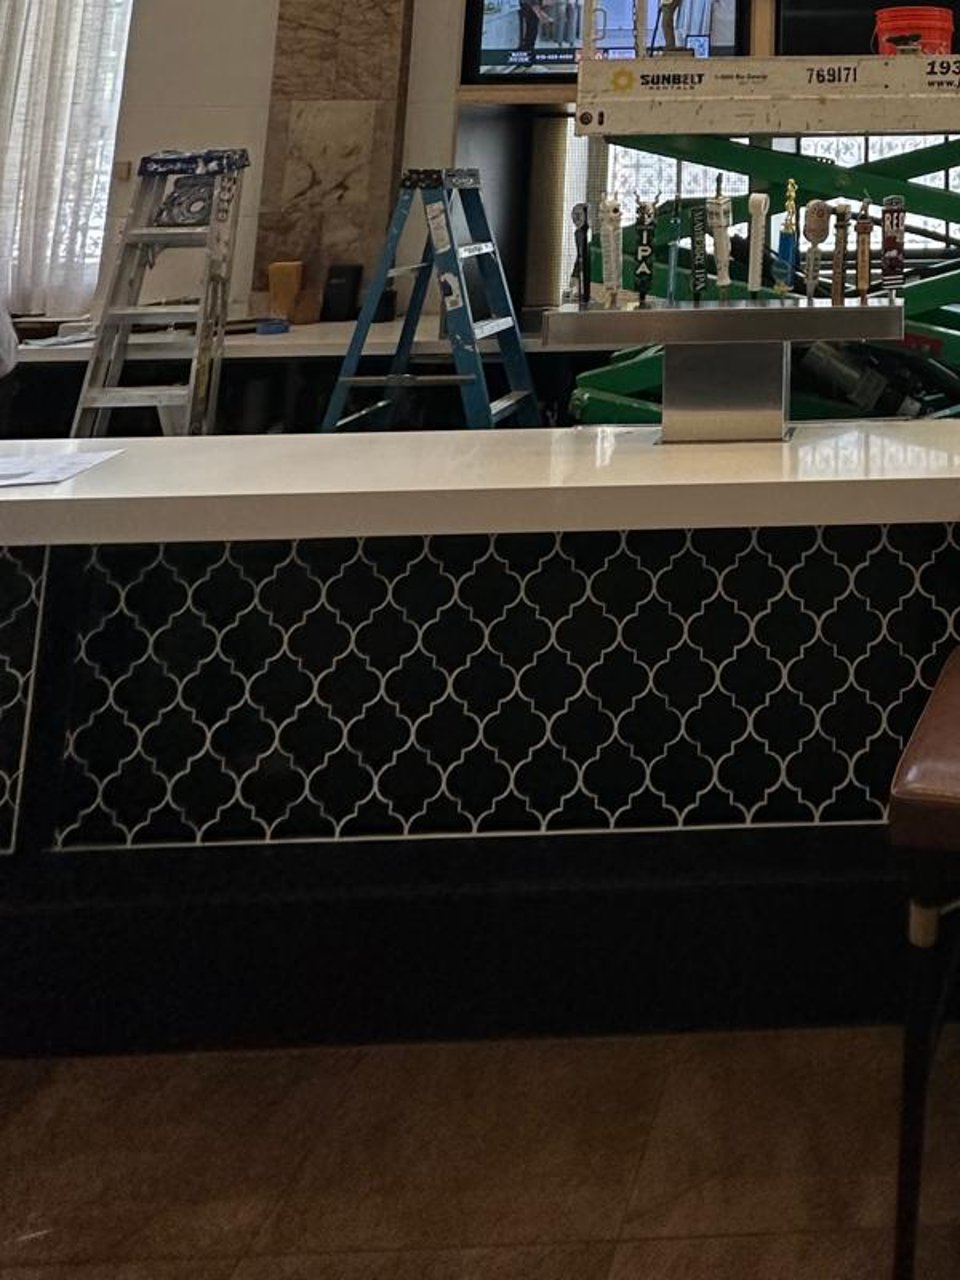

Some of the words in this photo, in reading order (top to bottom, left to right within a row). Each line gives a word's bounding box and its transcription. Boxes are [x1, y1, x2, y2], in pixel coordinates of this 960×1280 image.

[640, 73, 704, 85] SUNBELT
[806, 66, 857, 84] 769171
[636, 230, 651, 275] IPA
